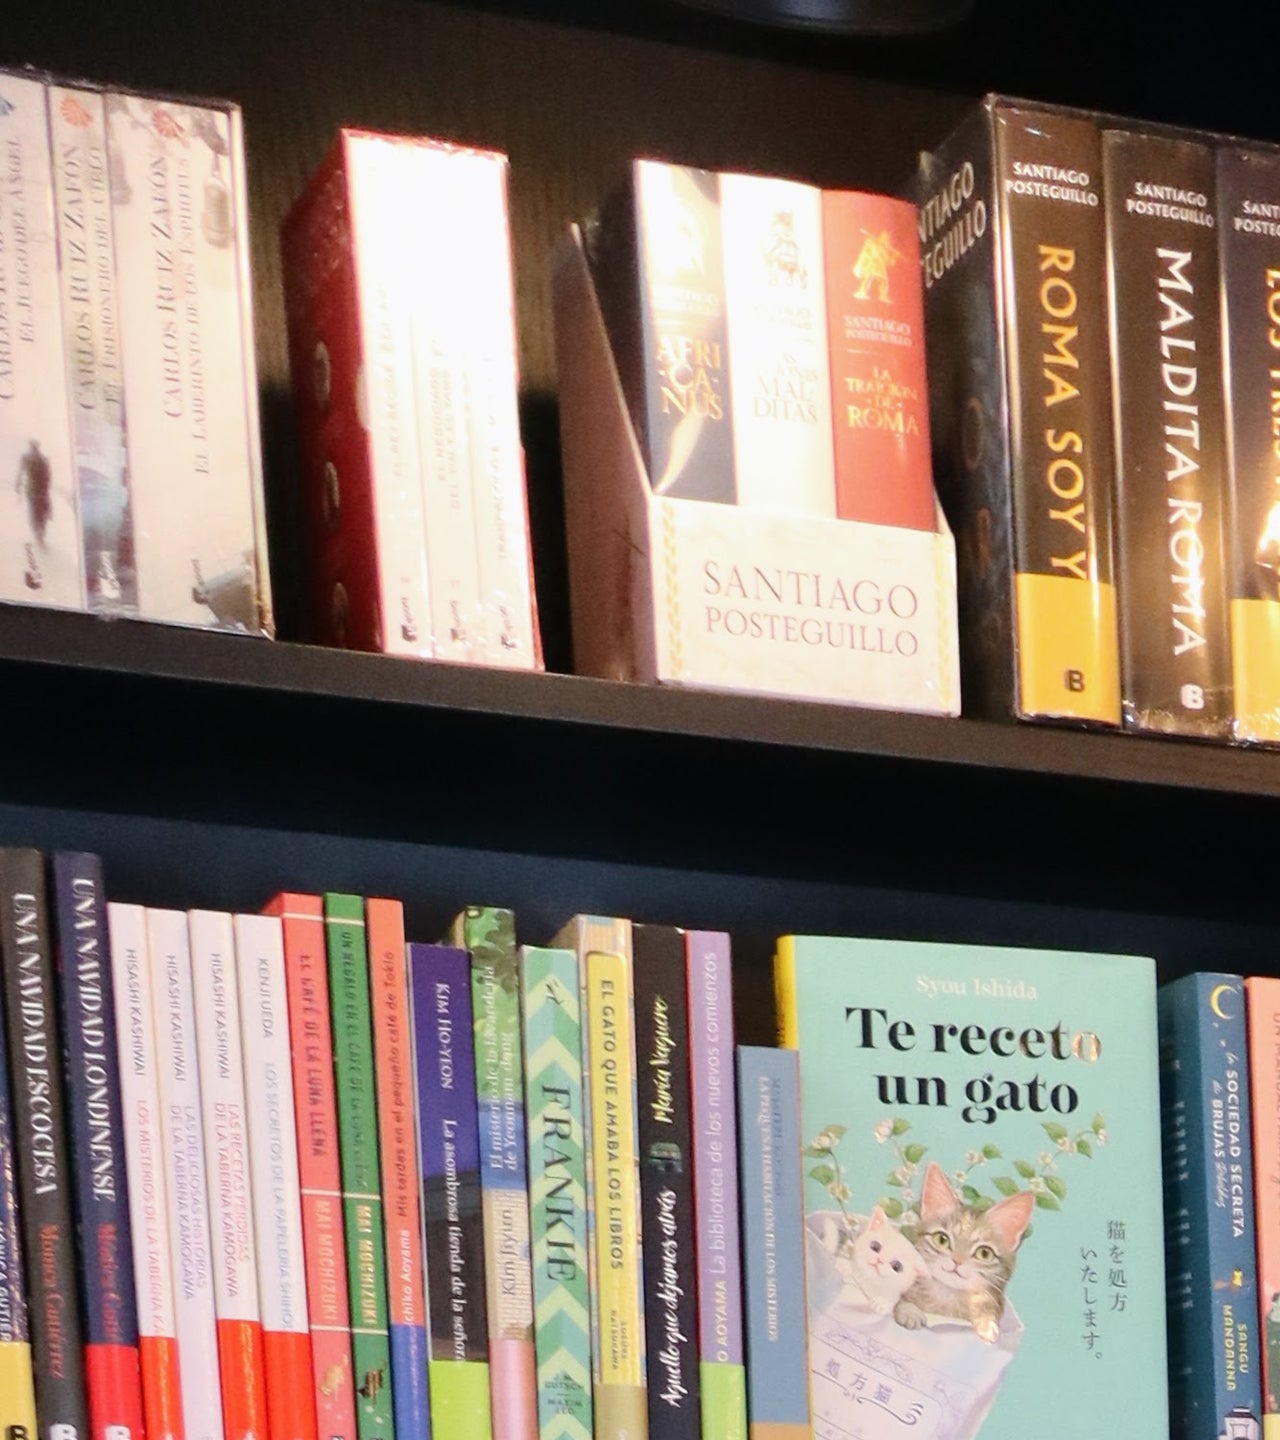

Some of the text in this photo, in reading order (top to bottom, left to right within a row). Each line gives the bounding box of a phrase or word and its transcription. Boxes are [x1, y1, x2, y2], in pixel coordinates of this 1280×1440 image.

[1006, 180, 1098, 206] POSTEGUILLO
[1013, 162, 1089, 186] SANTIAGO
[1038, 244, 1087, 534] ROMA SOY
[1155, 246, 1208, 656] MALDITA ROMA
[703, 559, 918, 620] SANTIAGO
[704, 606, 918, 657] POSTEGUILLO
[916, 974, 1038, 1000] Syou Ishida
[845, 1006, 1101, 1062] Te receto
[601, 979, 625, 1271] EL GATO QUE AMABA LOS LIBROS
[876, 1075, 1079, 1124] un gato
[541, 1084, 576, 1282] FRANKIE
[1106, 1220, 1128, 1312] 猫を処方
